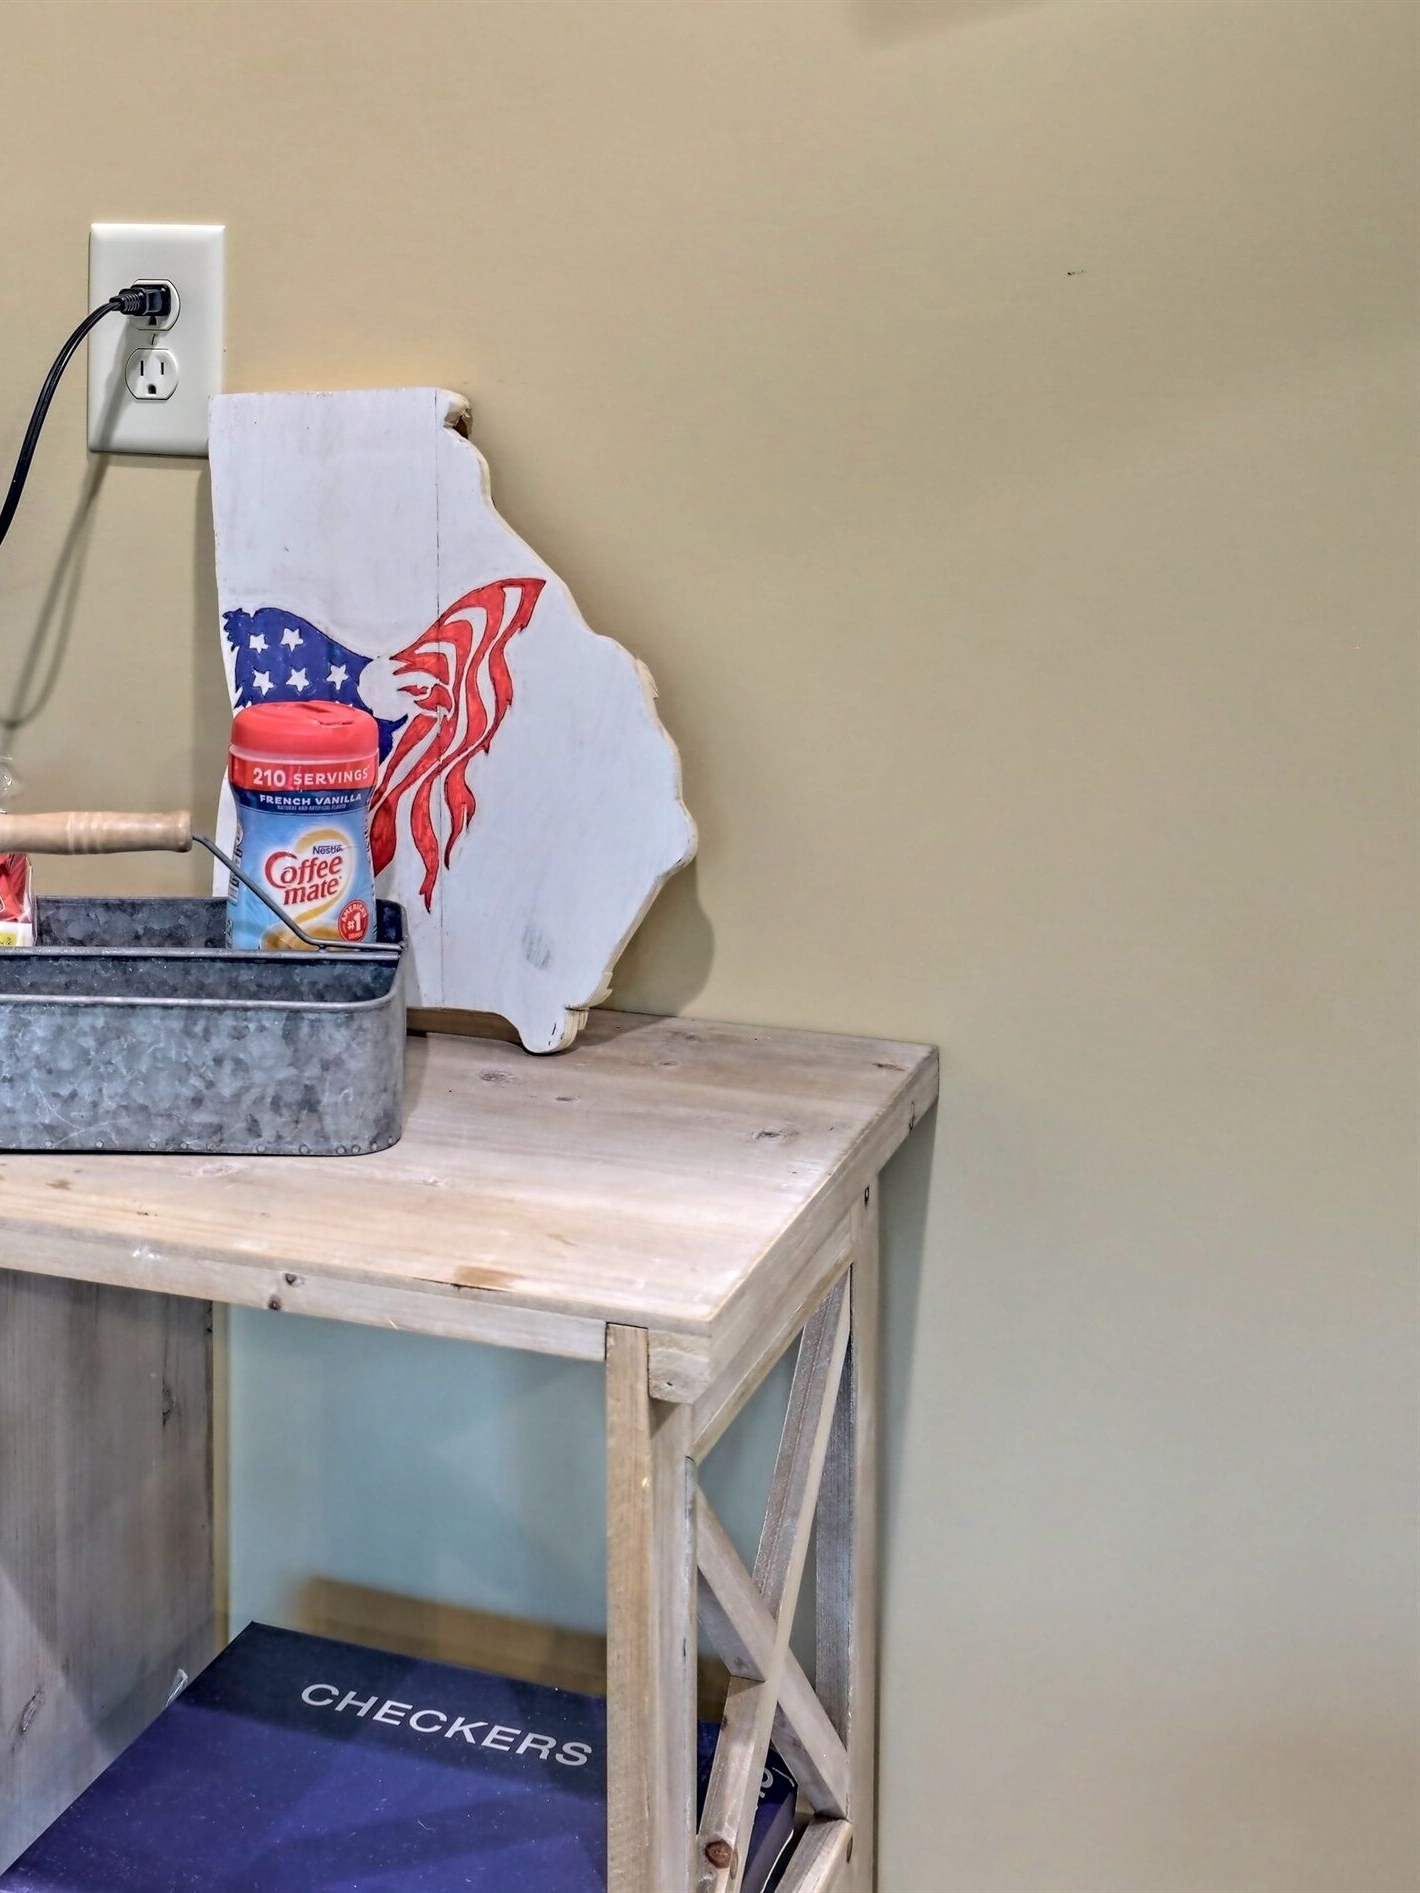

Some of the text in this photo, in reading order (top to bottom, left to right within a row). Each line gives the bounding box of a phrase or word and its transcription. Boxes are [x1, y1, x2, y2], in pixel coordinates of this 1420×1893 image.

[253, 768, 368, 787] 210 SERVINGS
[260, 794, 361, 805] FRENCH VANILLA
[265, 851, 343, 889] Coffee
[283, 878, 339, 905] mate
[347, 912, 361, 931] #1
[301, 1683, 592, 1766] CHECKERS
